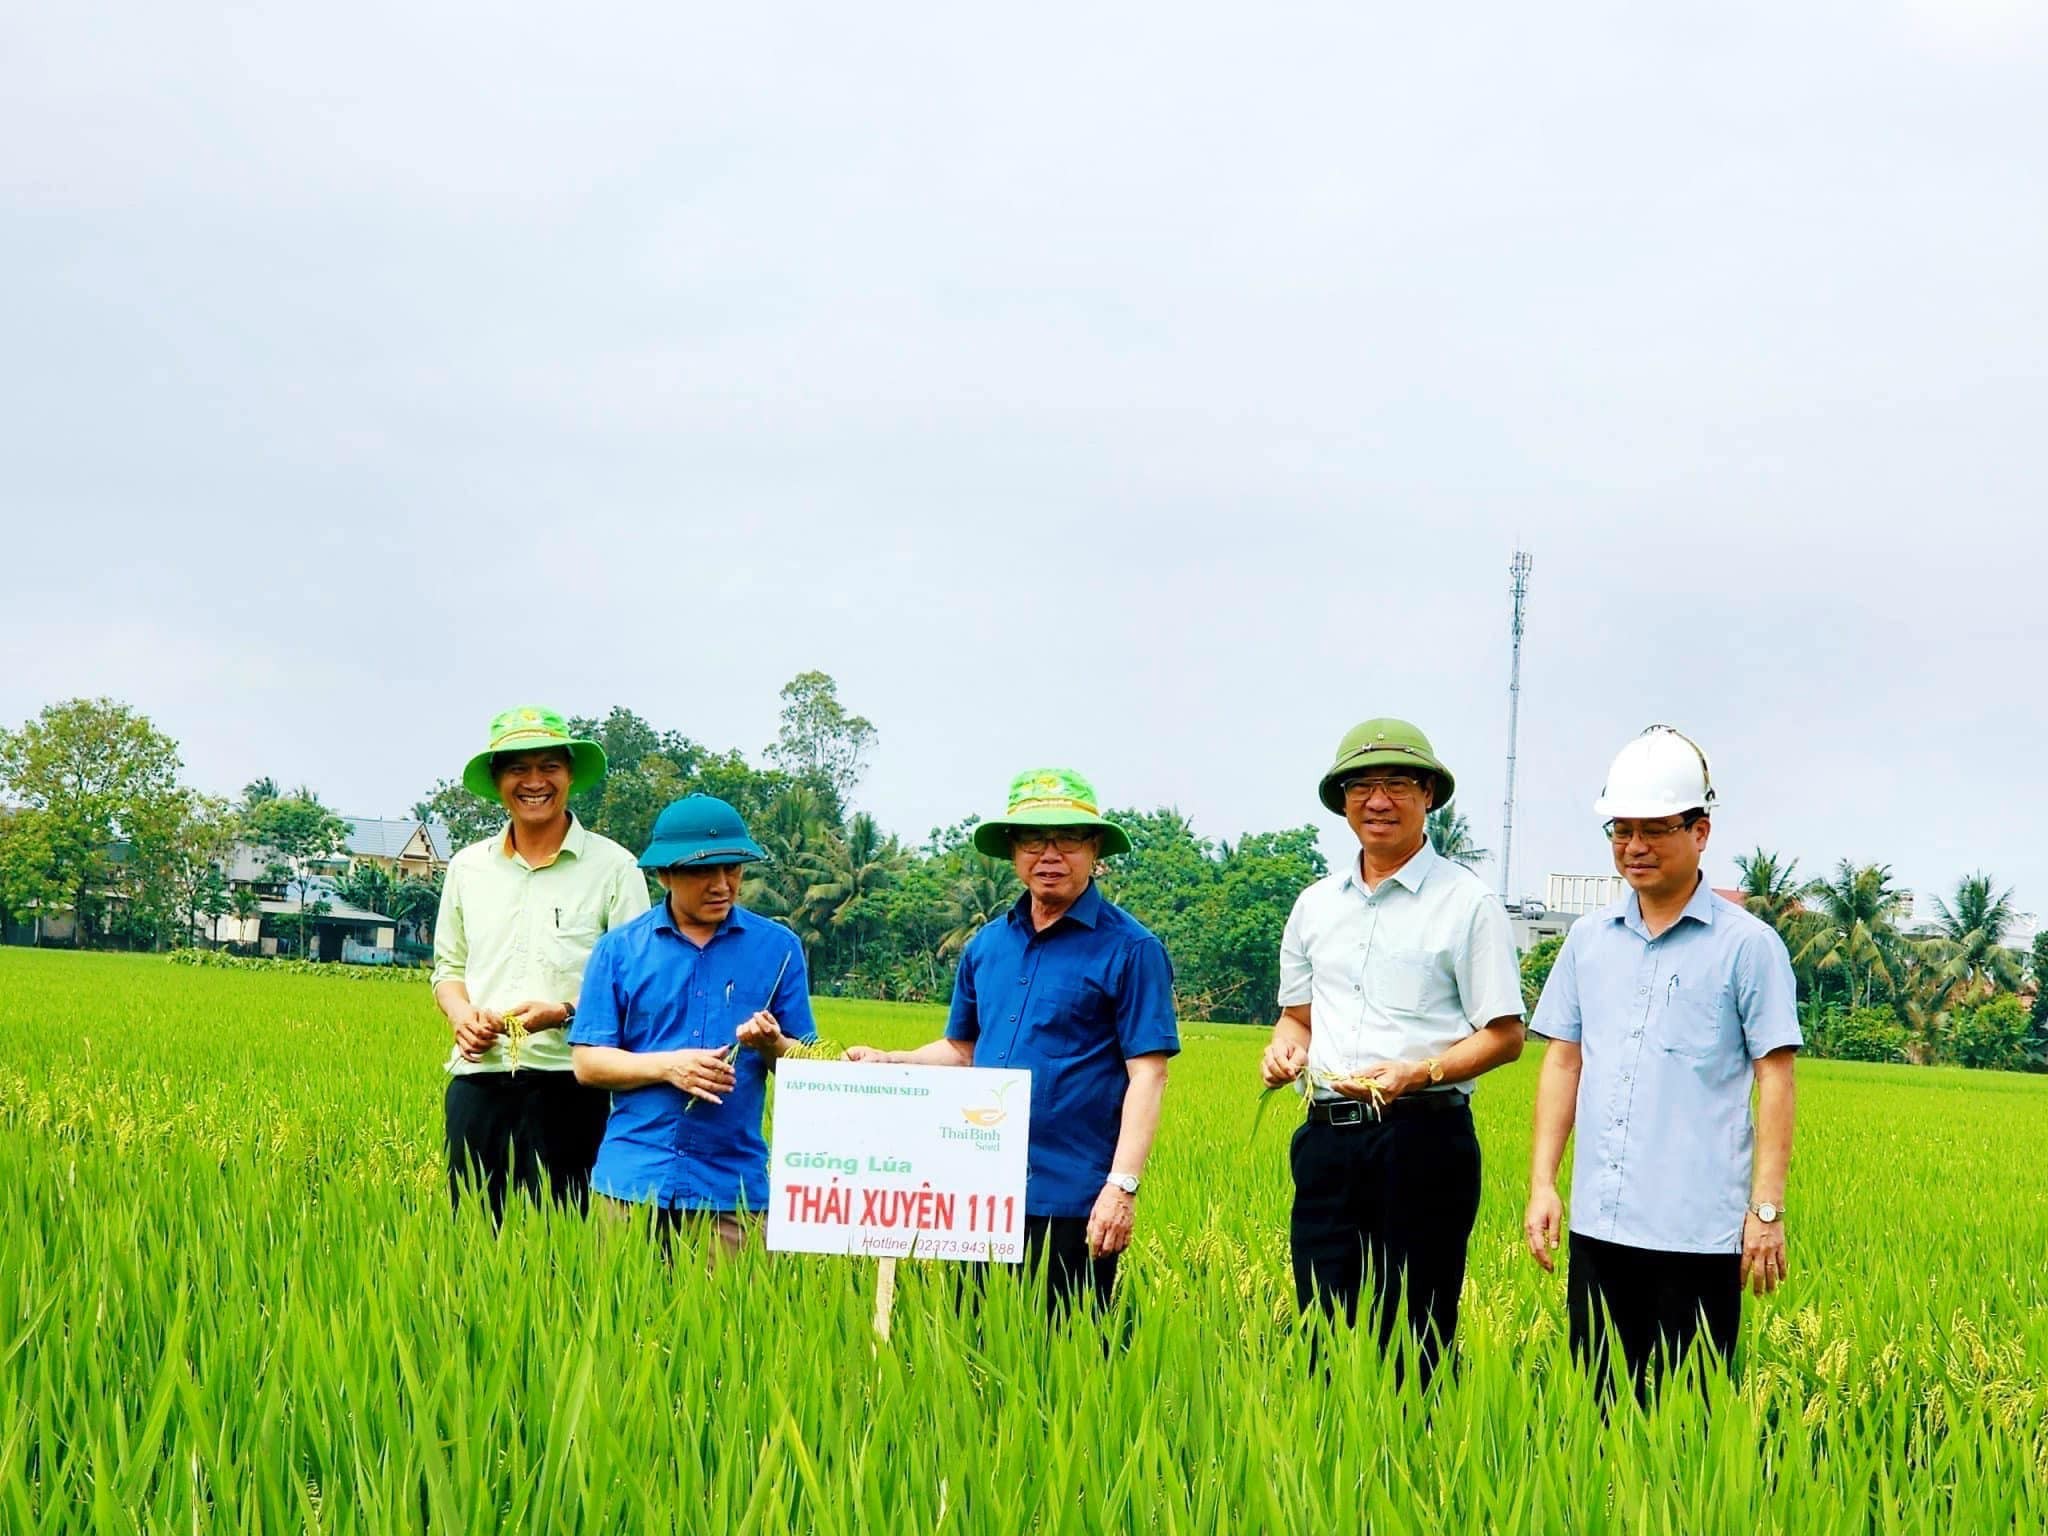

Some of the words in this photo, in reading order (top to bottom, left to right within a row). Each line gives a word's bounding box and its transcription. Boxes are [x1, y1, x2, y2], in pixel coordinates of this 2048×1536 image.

[975, 1140, 1000, 1152] Seed
[868, 1155, 913, 1173] Lúa
[859, 1182, 955, 1231] XUYÊN
[967, 1194, 1015, 1233] 111
